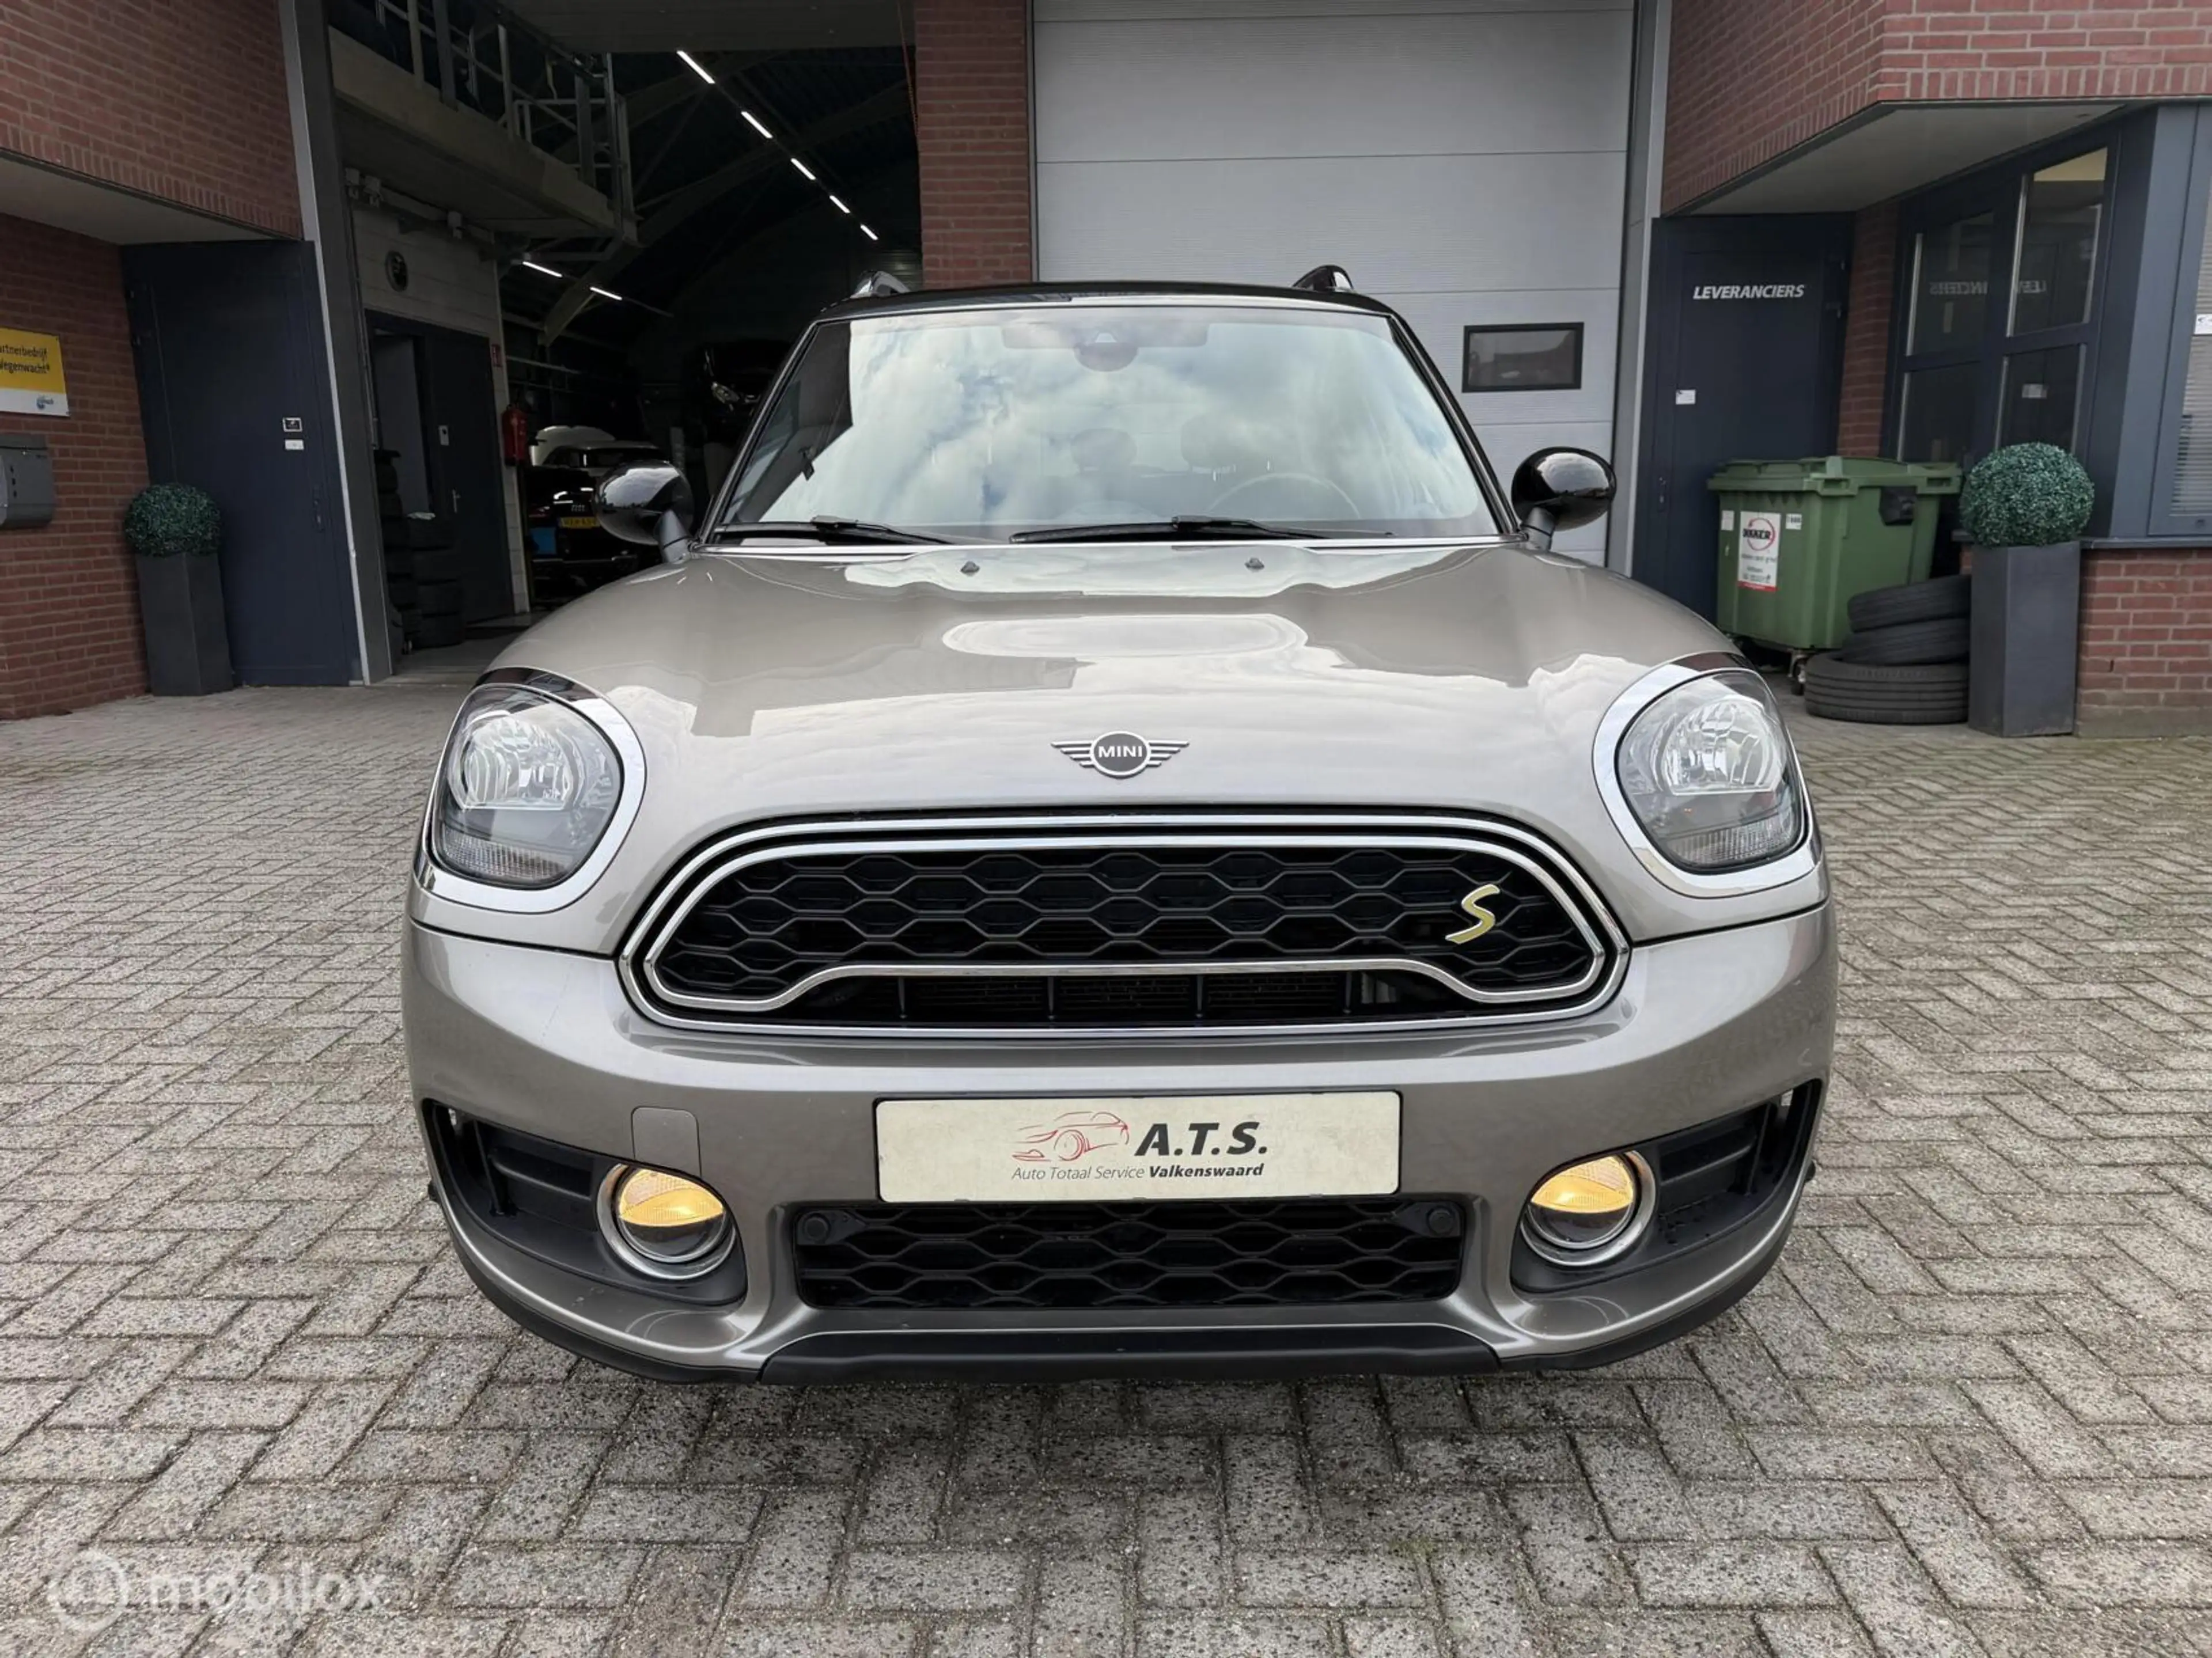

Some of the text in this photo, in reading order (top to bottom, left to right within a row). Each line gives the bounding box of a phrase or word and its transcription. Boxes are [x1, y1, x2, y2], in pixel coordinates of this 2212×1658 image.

[1693, 284, 1805, 299] LEVERANCIERS
[1099, 746, 1143, 758] MINI
[1445, 883, 1501, 945] S
[1134, 1121, 1268, 1156] A.T.S.
[1012, 1163, 1265, 1180] Auto Totaal Service Valkenswaard
